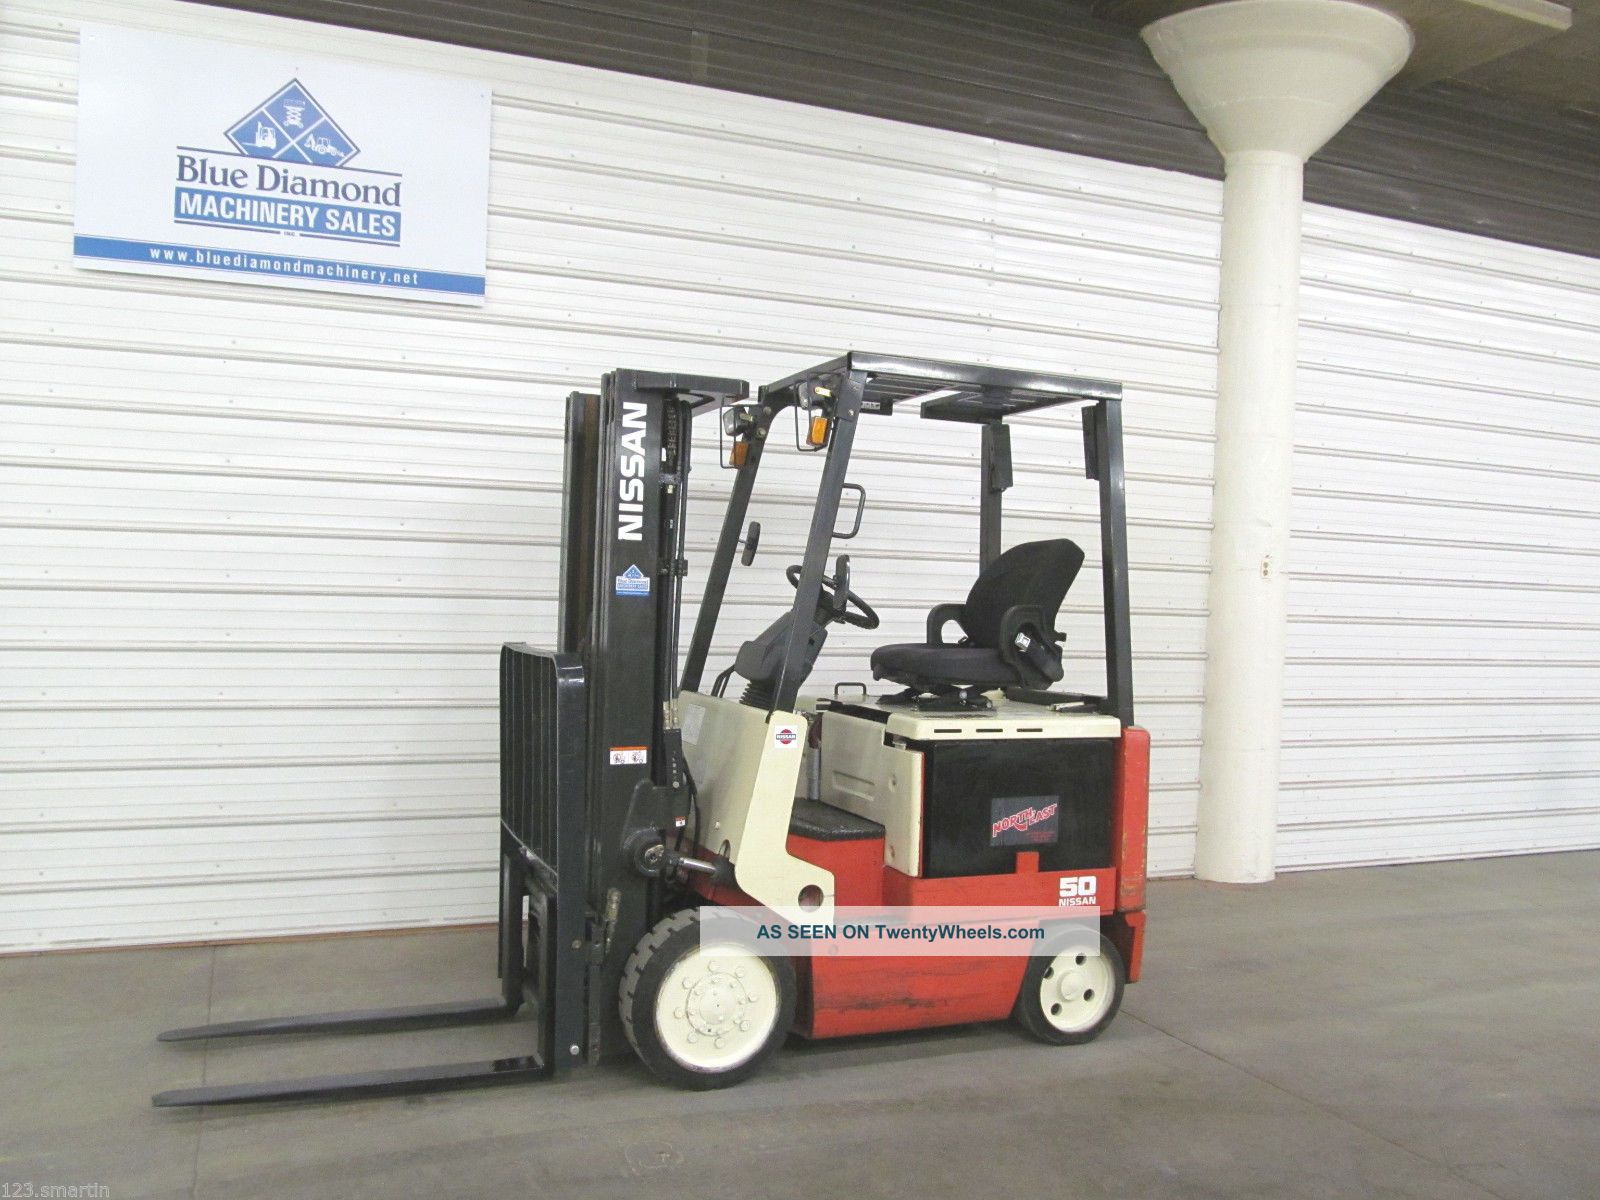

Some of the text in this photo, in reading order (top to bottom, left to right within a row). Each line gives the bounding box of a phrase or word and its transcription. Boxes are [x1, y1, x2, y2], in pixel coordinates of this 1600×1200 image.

[176, 154, 402, 207] Blue Diamond
[180, 192, 396, 237] MACHINERY SALES
[149, 246, 420, 287] www.bluediamondmachinery.net
[618, 401, 648, 541] NISSAN
[1058, 896, 1096, 907] NISSAN
[1059, 875, 1097, 897] 50
